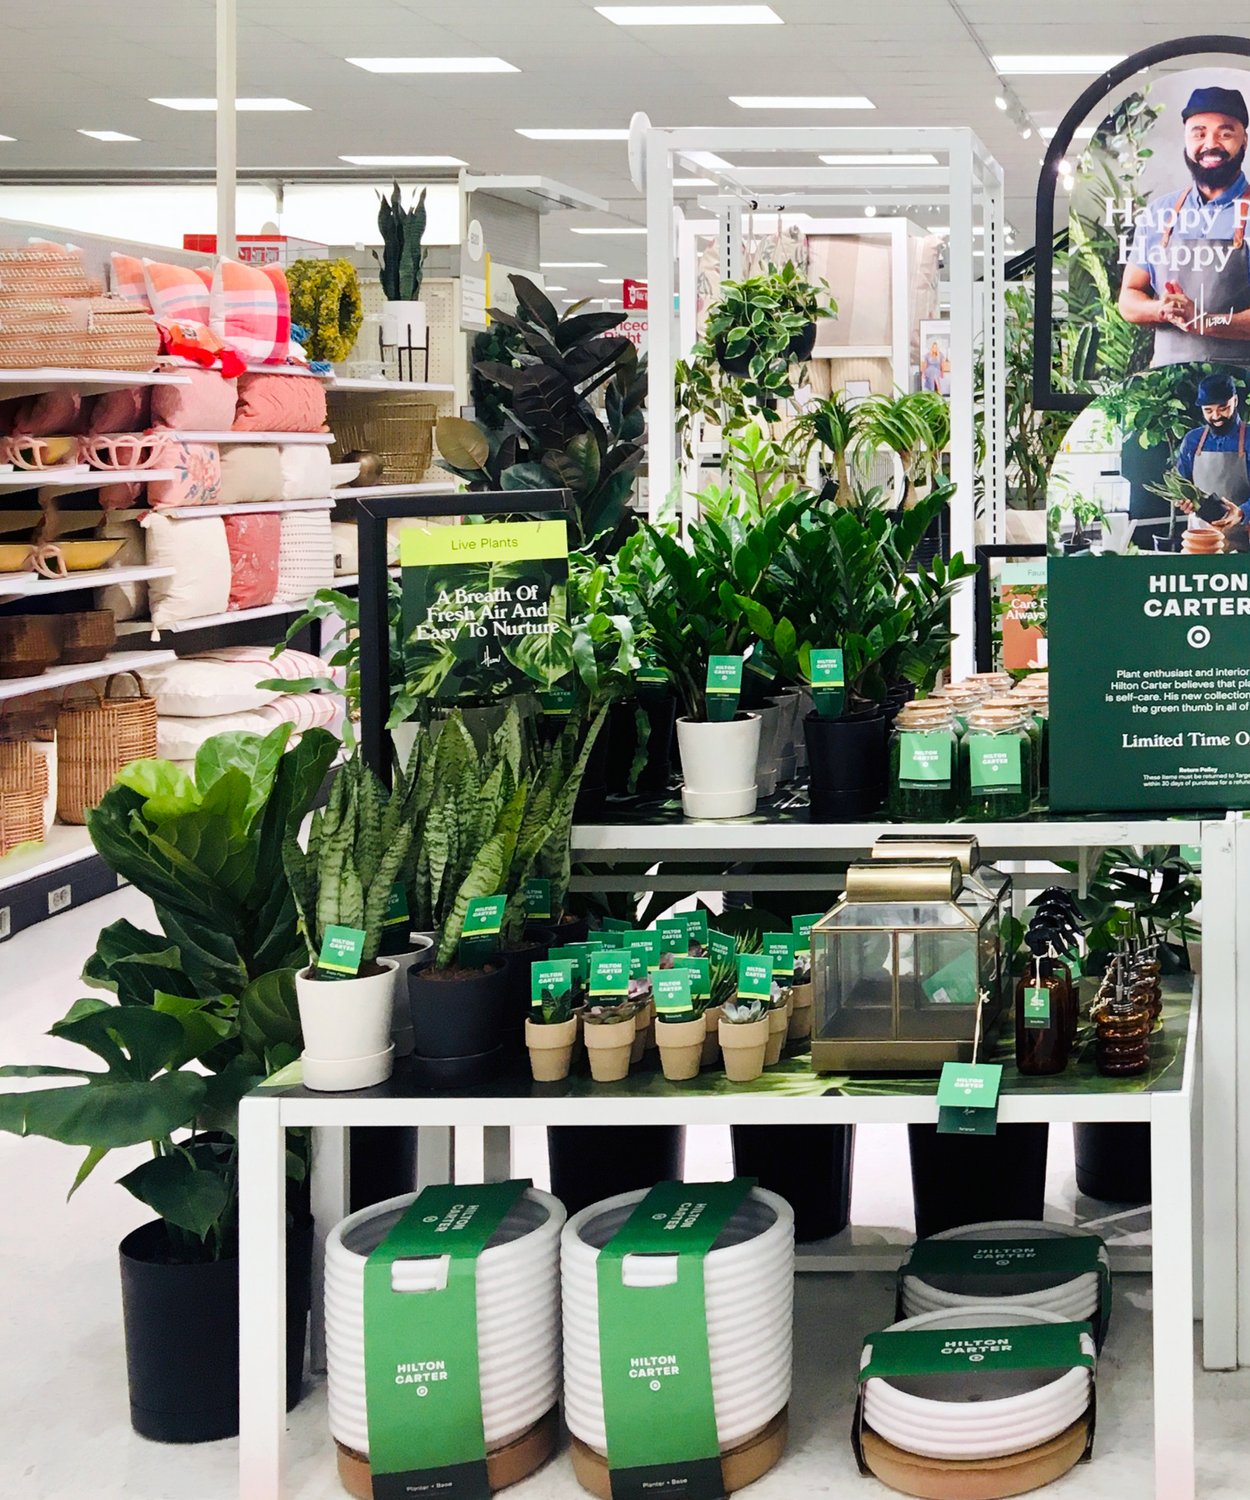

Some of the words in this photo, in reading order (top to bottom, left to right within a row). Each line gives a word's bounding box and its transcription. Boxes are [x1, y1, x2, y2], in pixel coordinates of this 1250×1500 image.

[1104, 198, 1221, 234] Happy
[1117, 235, 1235, 271] Happy
[451, 539, 476, 551] Live
[480, 537, 519, 549] Plants
[1027, 569, 1045, 577] Faux
[1149, 573, 1248, 593] HILTON
[437, 590, 450, 604] A
[455, 587, 512, 603] Breath
[516, 585, 539, 601] Of
[1010, 598, 1038, 609] Care
[426, 606, 476, 623] Fresh
[481, 604, 508, 620] Air
[511, 602, 548, 618] And
[1006, 609, 1046, 621] Always
[416, 624, 460, 641] Easy
[465, 622, 488, 637] To
[493, 621, 561, 636] Nurture
[1116, 670, 1141, 679] Plant
[1143, 669, 1193, 678] enthusiast
[1195, 668, 1213, 677] and
[1215, 668, 1250, 677] interior
[1111, 681, 1139, 690] Hilton
[1140, 681, 1172, 690] Carter
[1174, 680, 1215, 689] believes
[1217, 680, 1235, 688] that
[1105, 693, 1114, 702] is
[1116, 692, 1162, 701] self-care.
[1164, 692, 1179, 700] His
[1181, 692, 1202, 700] new
[1204, 691, 1250, 700] collection
[1132, 704, 1149, 713] the
[1150, 705, 1180, 714] green
[1182, 703, 1213, 712] thumb
[1215, 703, 1224, 711] in
[1226, 702, 1237, 711] all
[1238, 702, 1249, 711] of
[1122, 732, 1183, 748] Limited
[1187, 732, 1231, 746] Time
[434, 1204, 464, 1232] CARTER
[452, 1204, 480, 1230] HILTON
[664, 1202, 692, 1230] CARTER
[680, 1203, 708, 1228] HILTON
[940, 1346, 1012, 1354] CARTER
[945, 1339, 1009, 1348] HILTON
[397, 1360, 445, 1374] HILTON
[630, 1356, 676, 1367] HILTON
[395, 1371, 448, 1385] CARTER
[628, 1366, 680, 1378] CARTER
[406, 1484, 430, 1492] Planter
[436, 1482, 453, 1490] Base
[642, 1480, 665, 1488] Planter
[671, 1478, 688, 1486] Base
